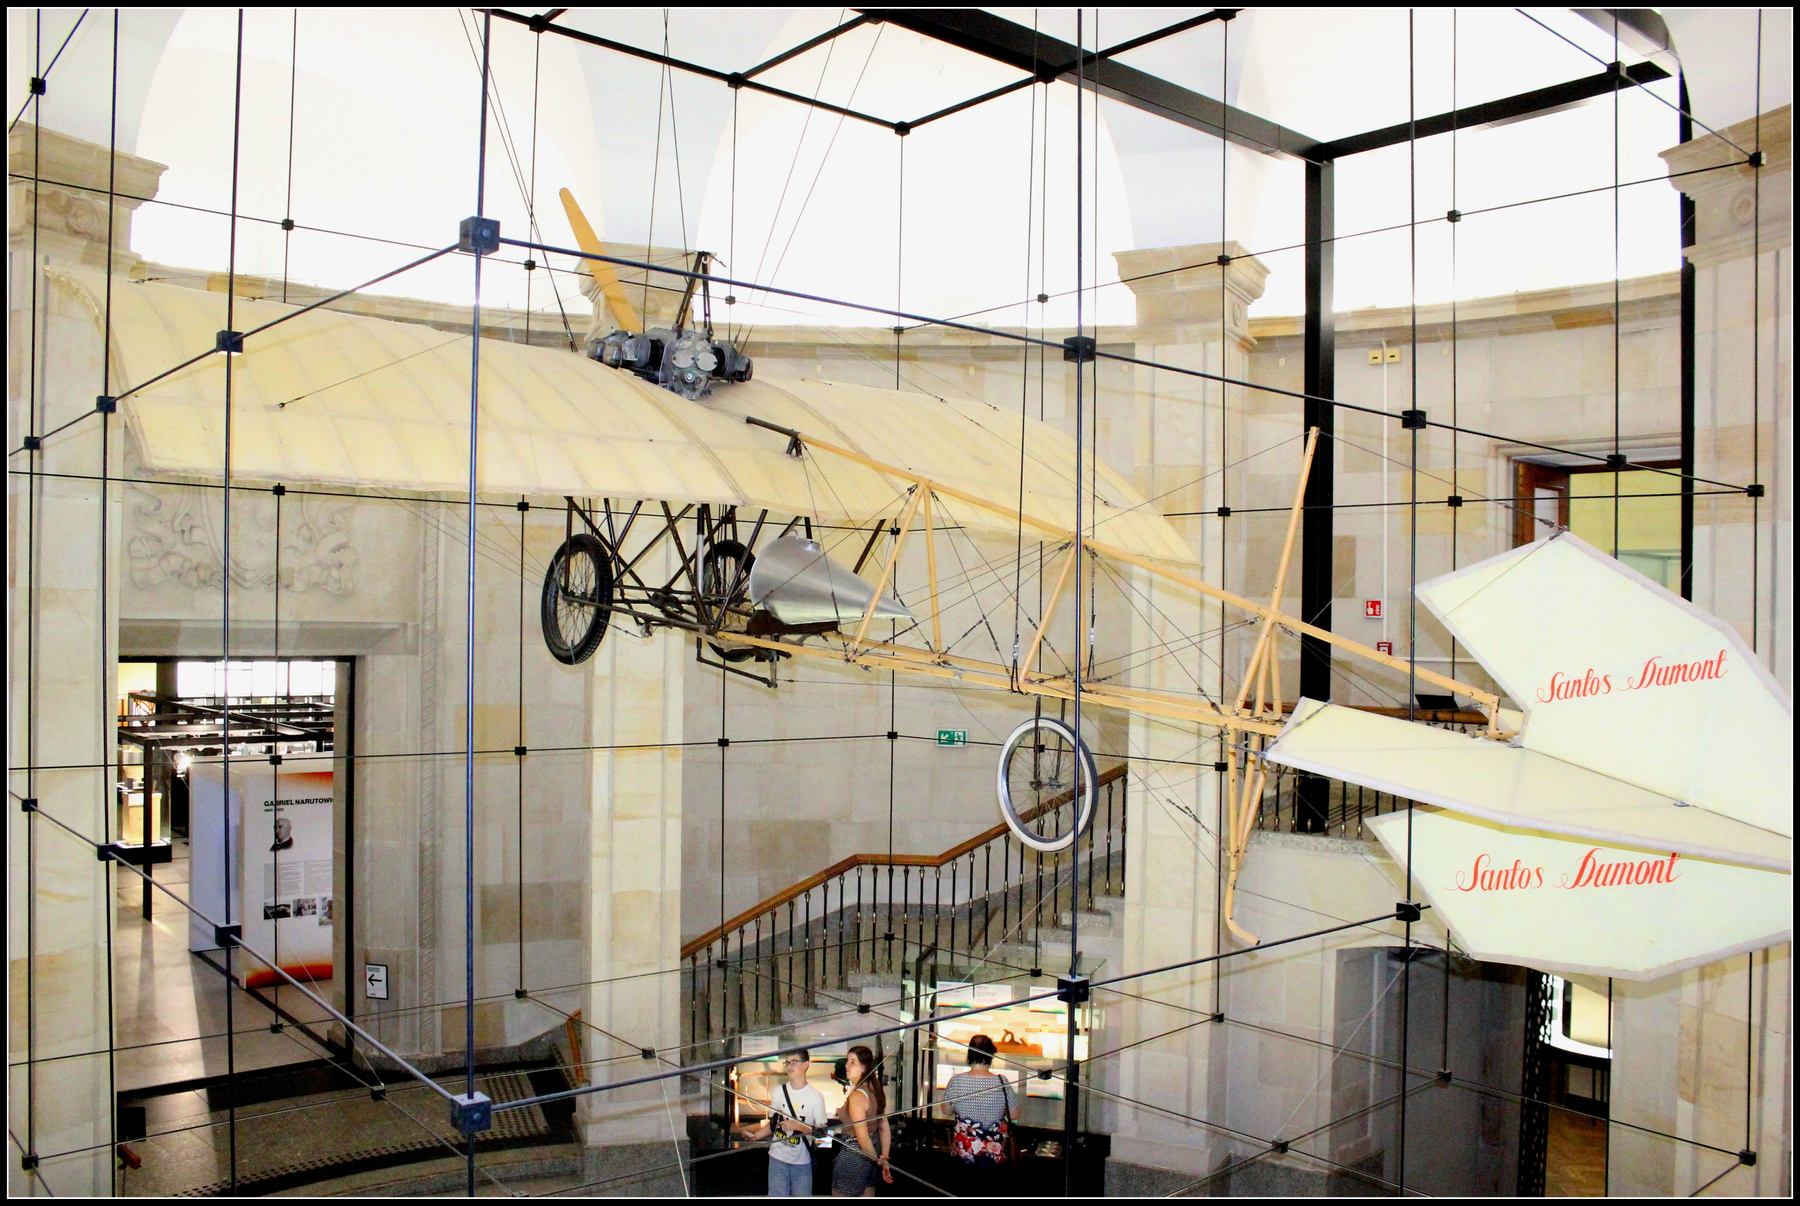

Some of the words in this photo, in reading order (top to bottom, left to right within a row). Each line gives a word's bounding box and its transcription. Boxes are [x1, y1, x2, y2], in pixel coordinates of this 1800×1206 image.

[1534, 668, 1612, 703] Santos
[1616, 649, 1729, 691] Dumont
[1442, 853, 1545, 892] Santos
[1550, 847, 1682, 890] Dumont
